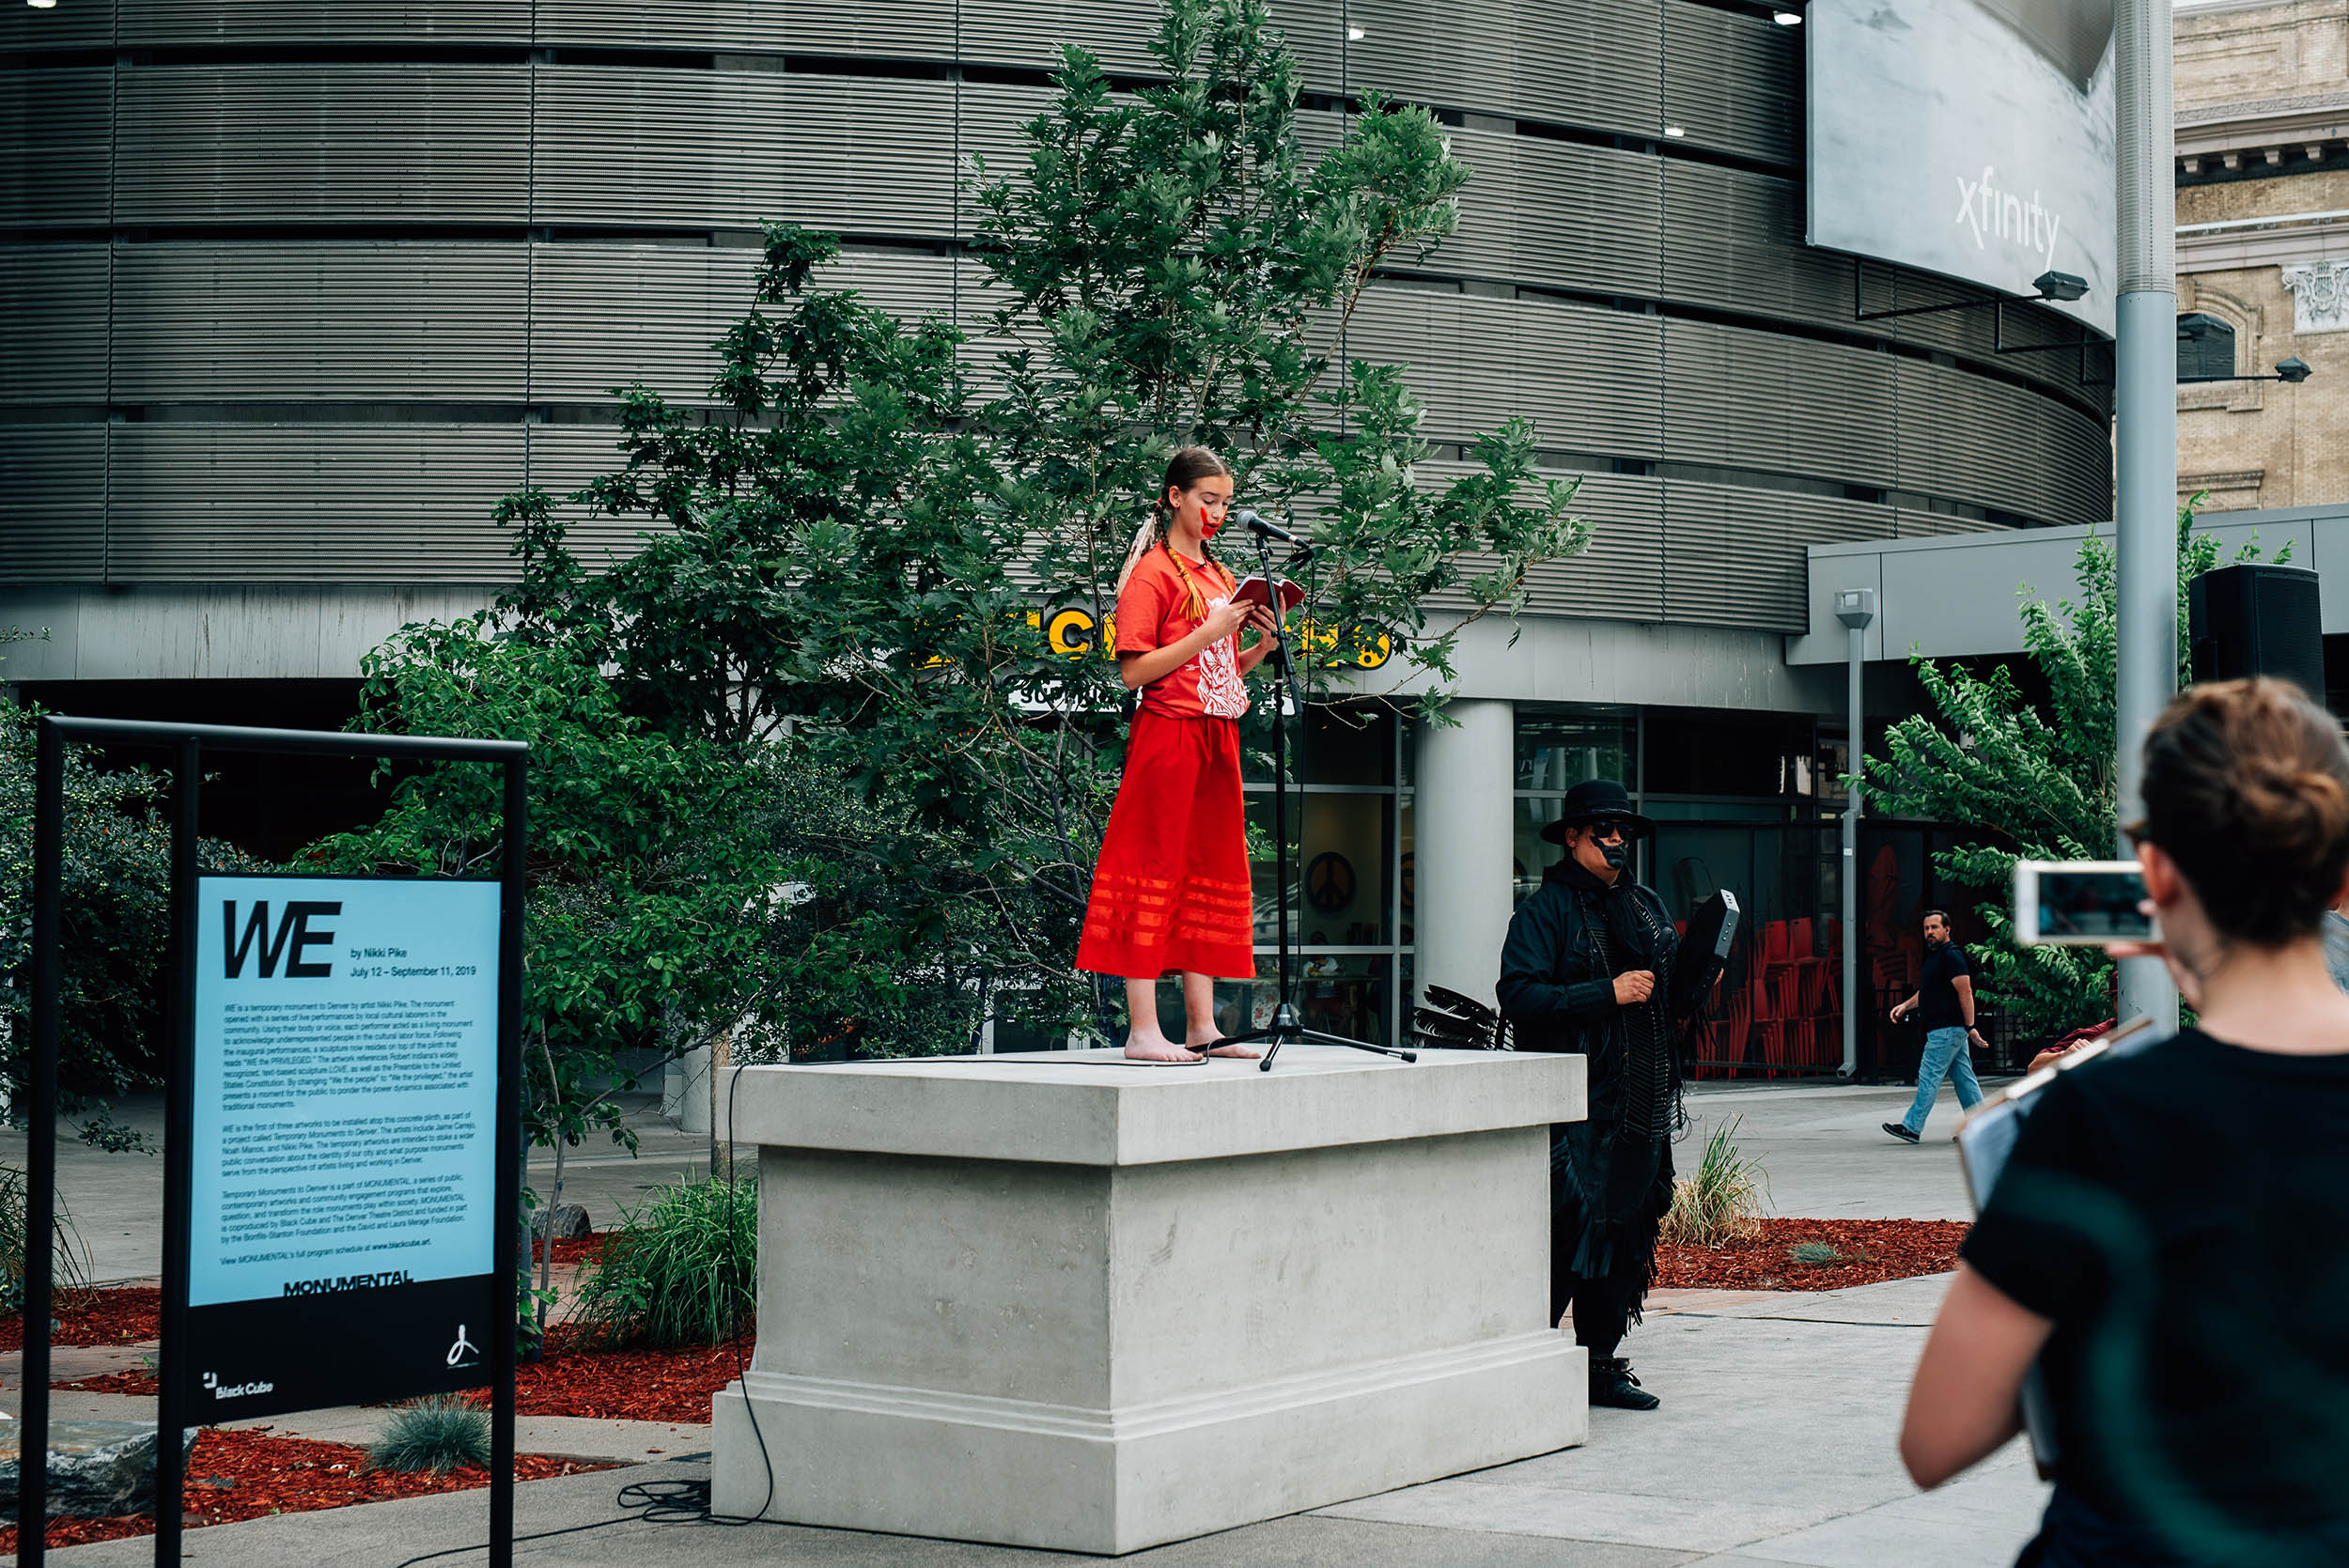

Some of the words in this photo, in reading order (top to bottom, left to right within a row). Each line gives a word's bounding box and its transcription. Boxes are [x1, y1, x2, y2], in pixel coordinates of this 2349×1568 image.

[1956, 165, 2060, 272] xfinity
[223, 900, 342, 979] WE
[350, 949, 362, 959] by
[365, 948, 385, 957] Nikki
[388, 948, 407, 957] Pike
[350, 967, 368, 979] July
[371, 968, 381, 976] 12
[391, 967, 438, 979] September
[441, 967, 453, 978] 11,
[456, 966, 476, 975] 2019
[284, 1270, 413, 1296] MONUMENTAL
[215, 1383, 244, 1400] Black
[246, 1382, 273, 1396] Cube
